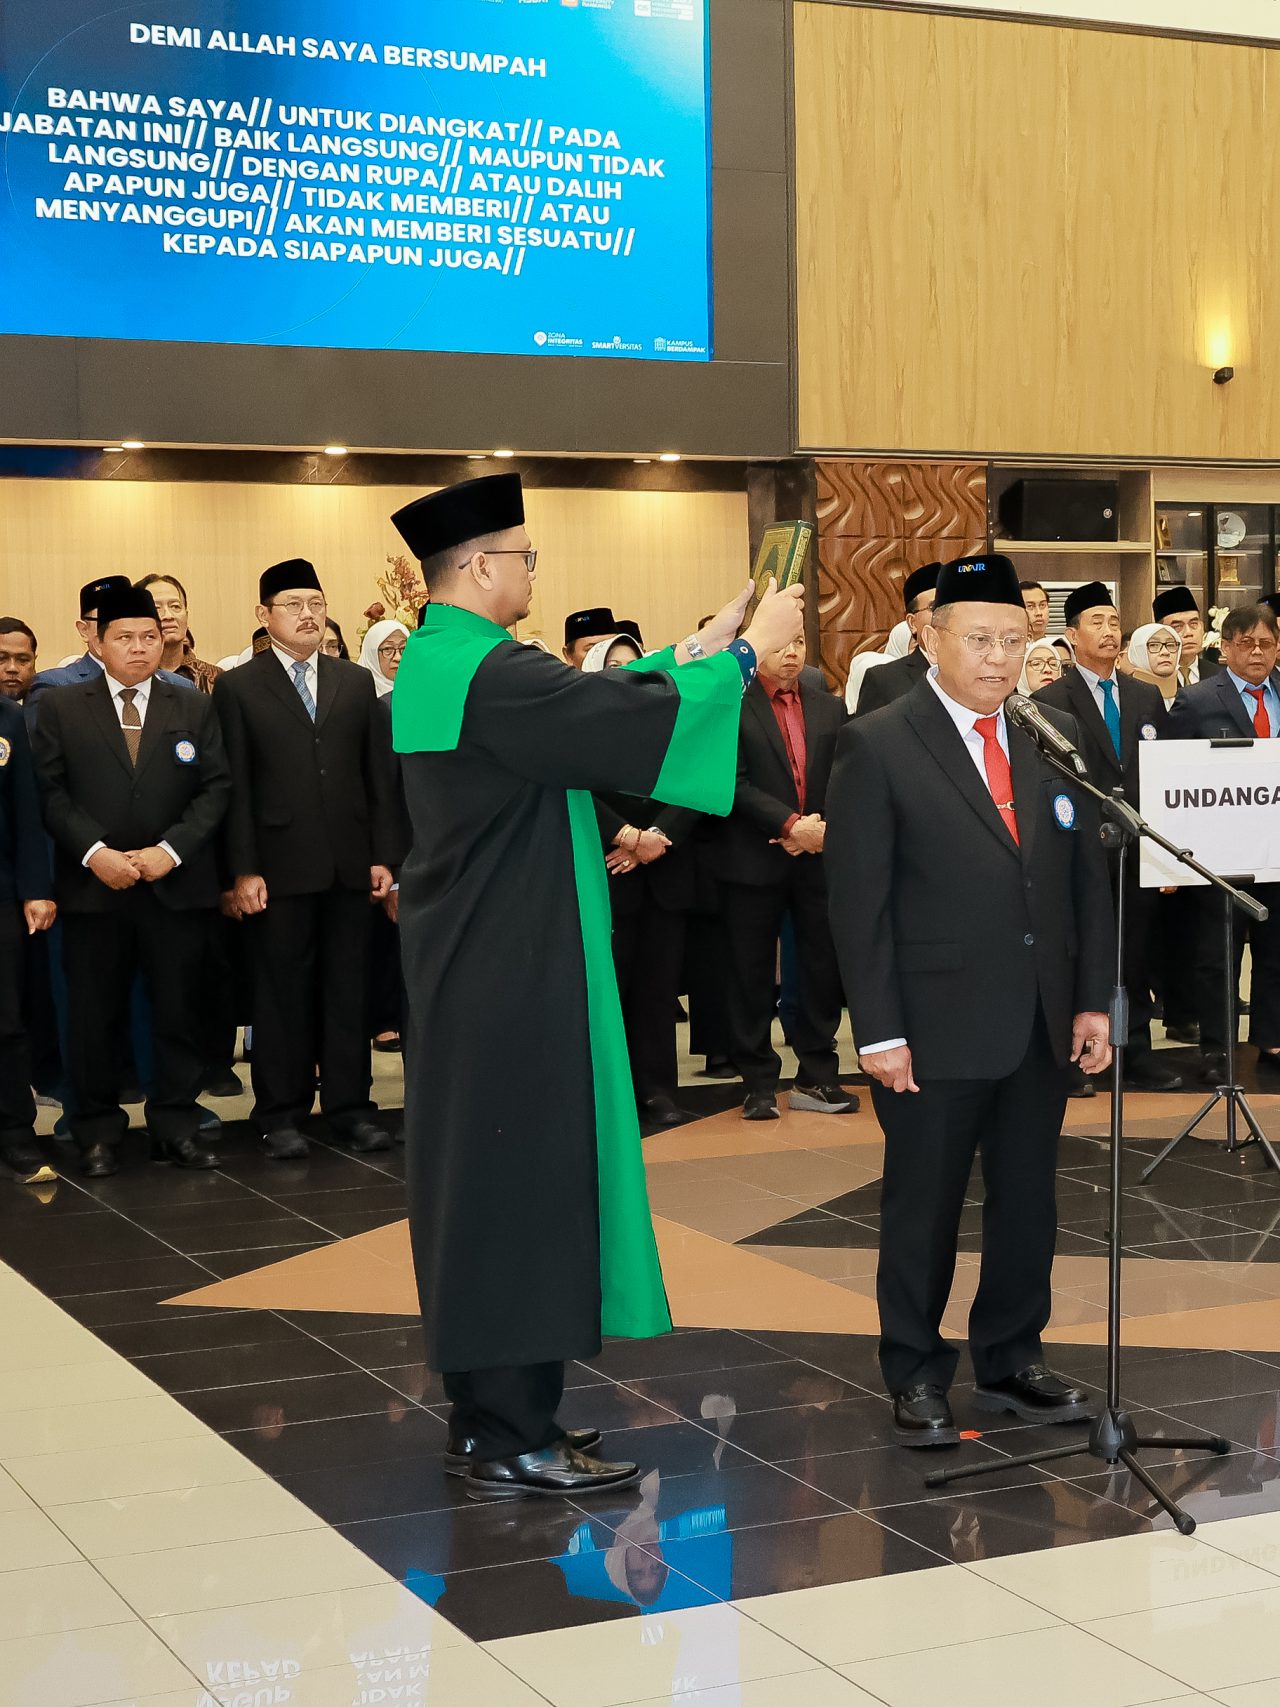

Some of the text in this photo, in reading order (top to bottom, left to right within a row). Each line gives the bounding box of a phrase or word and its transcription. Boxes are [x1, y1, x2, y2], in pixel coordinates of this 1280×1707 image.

[130, 23, 547, 77] DEMI ALLAH SAYA BERSUMPAH
[0, 112, 665, 178] JABATAN INI// BAIK LANGSUNG// MAUPUN TIDAK
[48, 88, 621, 149] BAHWA SAYA// UNTUK DIANGKAT// PADA
[48, 143, 622, 200] LANGSUNG// DENGAN RUPA// ATAU DALIH
[63, 172, 610, 225] APAPUN JUGA// TIDAK MEMBERI// ATAU
[35, 198, 636, 256] MENYANGGUPI// AKAN MEMBERI SESUATU//
[163, 232, 525, 275] KEPADA SIAPAPUN JUGA//
